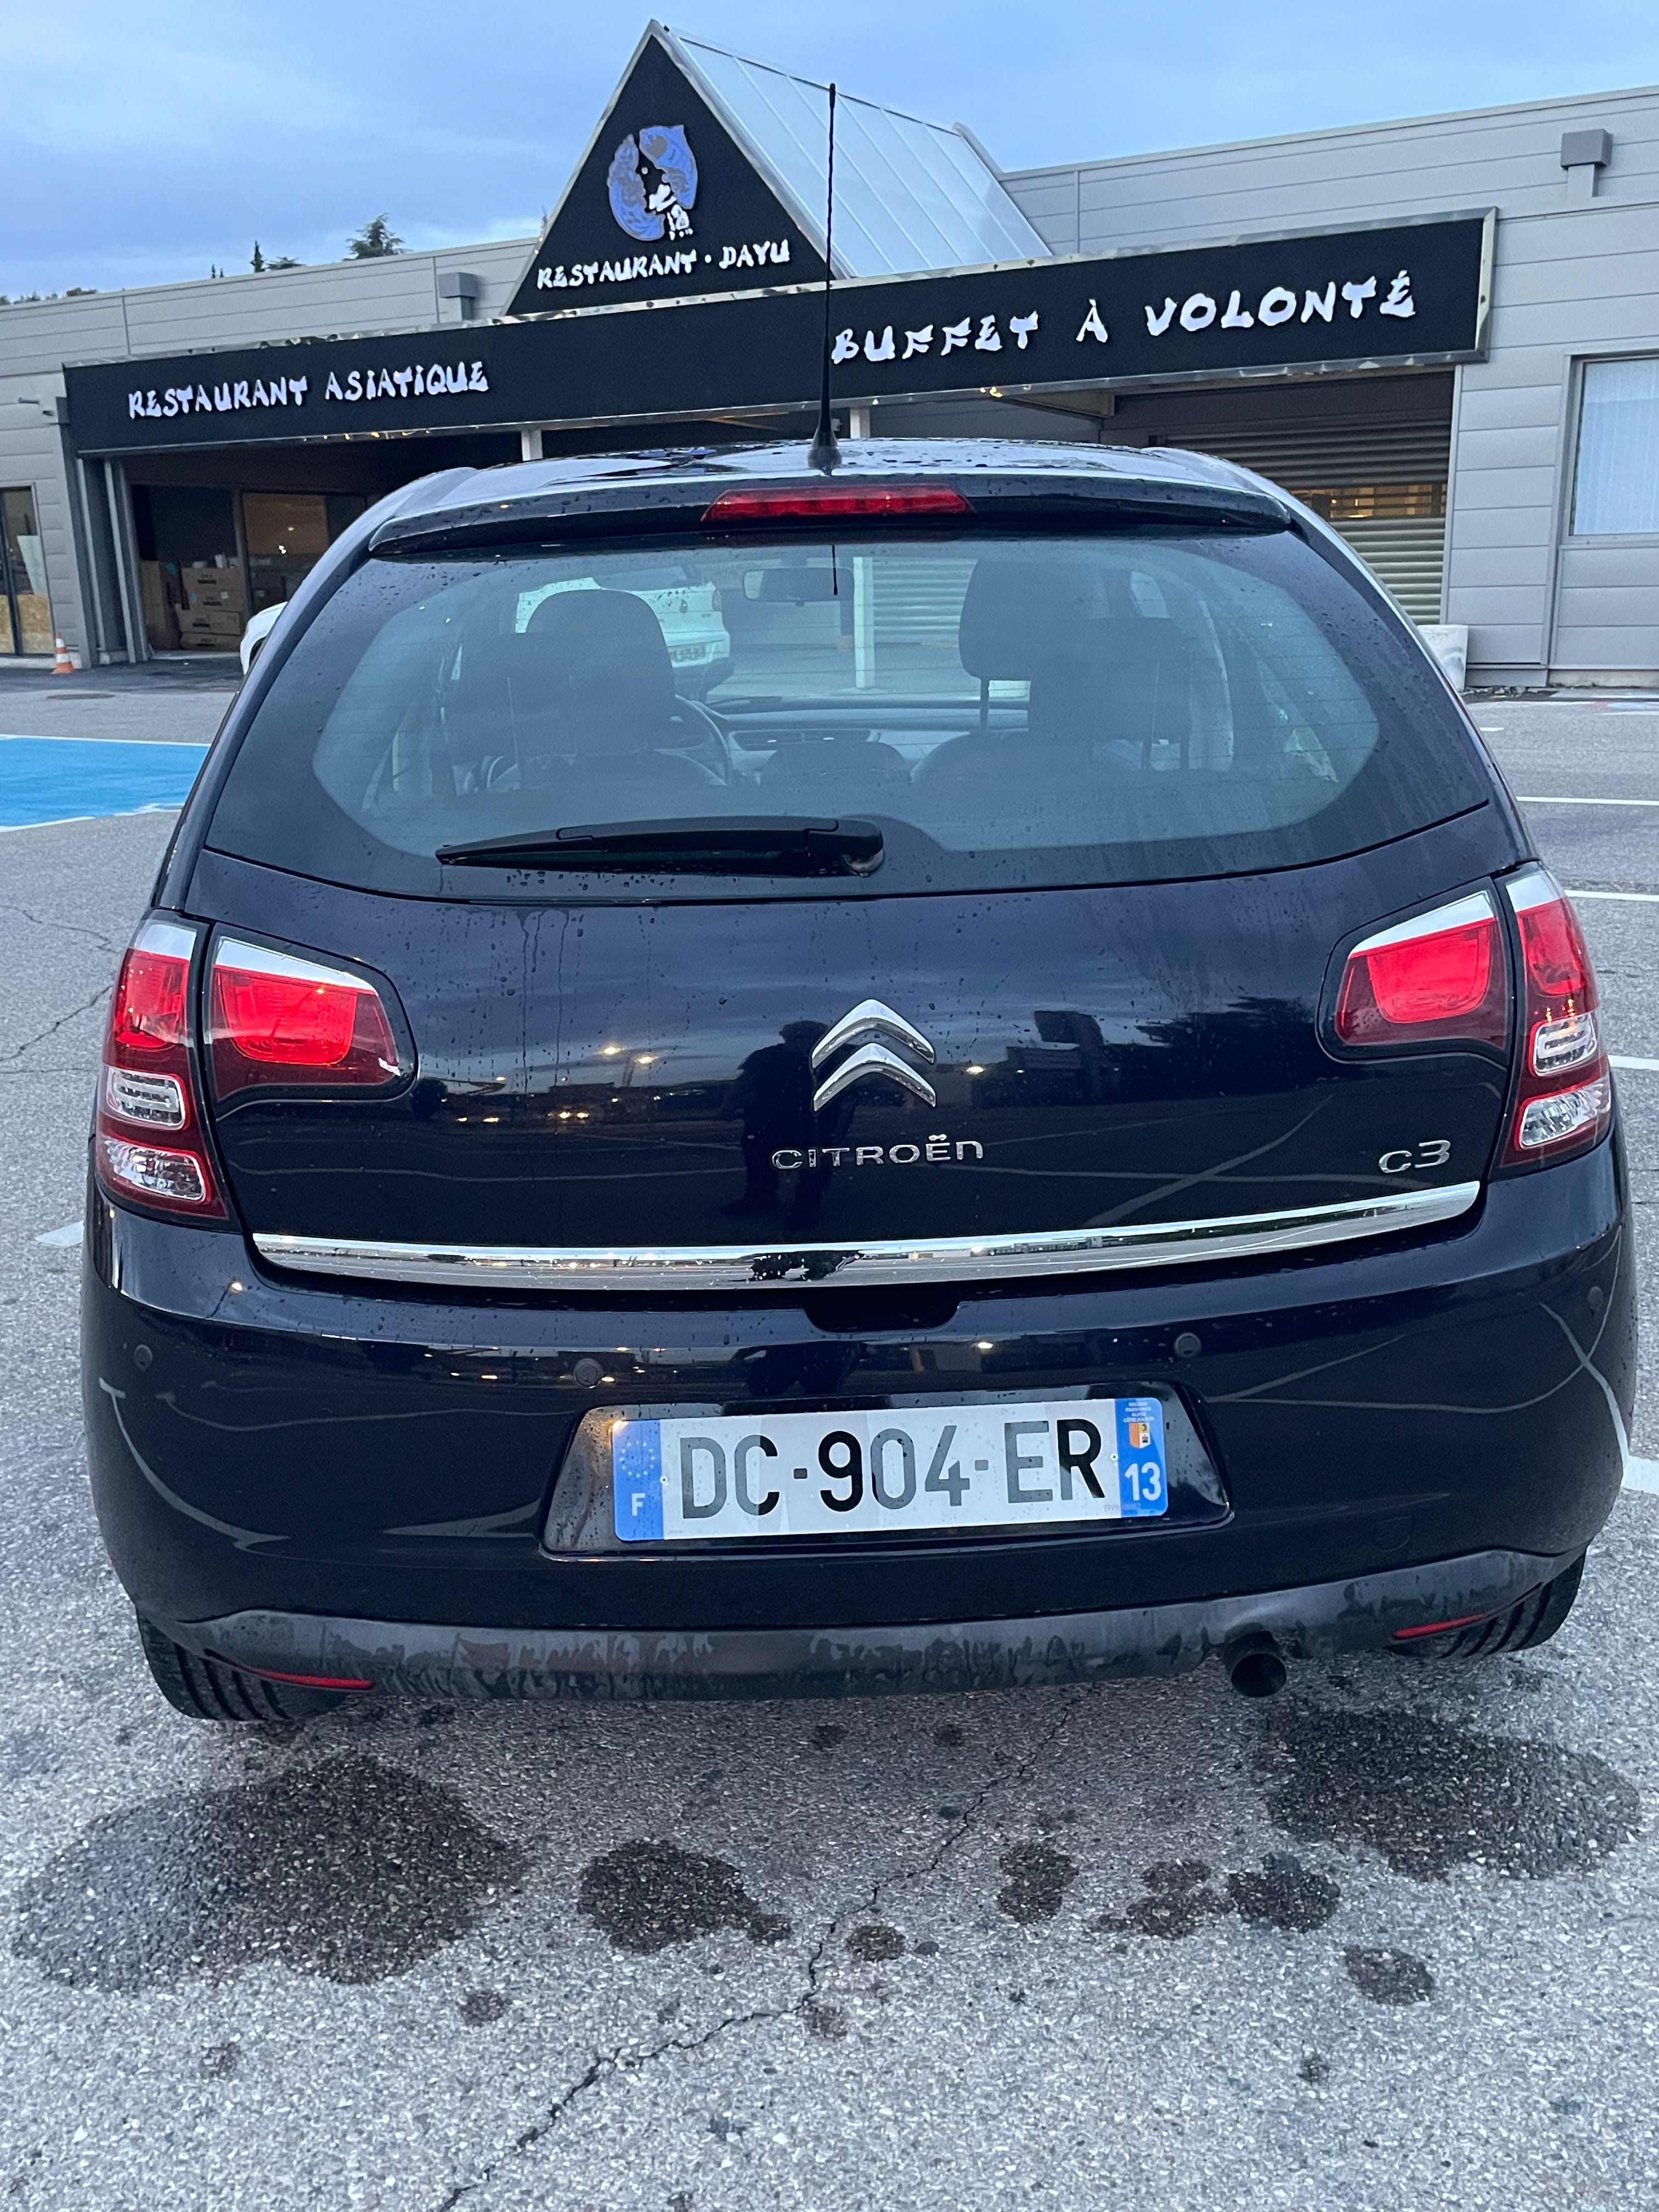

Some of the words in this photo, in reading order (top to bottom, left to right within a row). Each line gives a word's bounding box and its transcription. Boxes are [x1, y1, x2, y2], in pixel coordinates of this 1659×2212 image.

[537, 249, 697, 289] RESTAURANT
[719, 239, 790, 269] DAYU
[831, 311, 1039, 364] BUFFET
[1076, 300, 1108, 343] À
[1144, 270, 1417, 336] VOLONTÉ
[128, 375, 308, 419] RESTAURANT
[325, 361, 489, 401] ASIATIQUE
[1378, 1139, 1451, 1173] C3
[1124, 1462, 1161, 1501] 13
[631, 1492, 646, 1516] F
